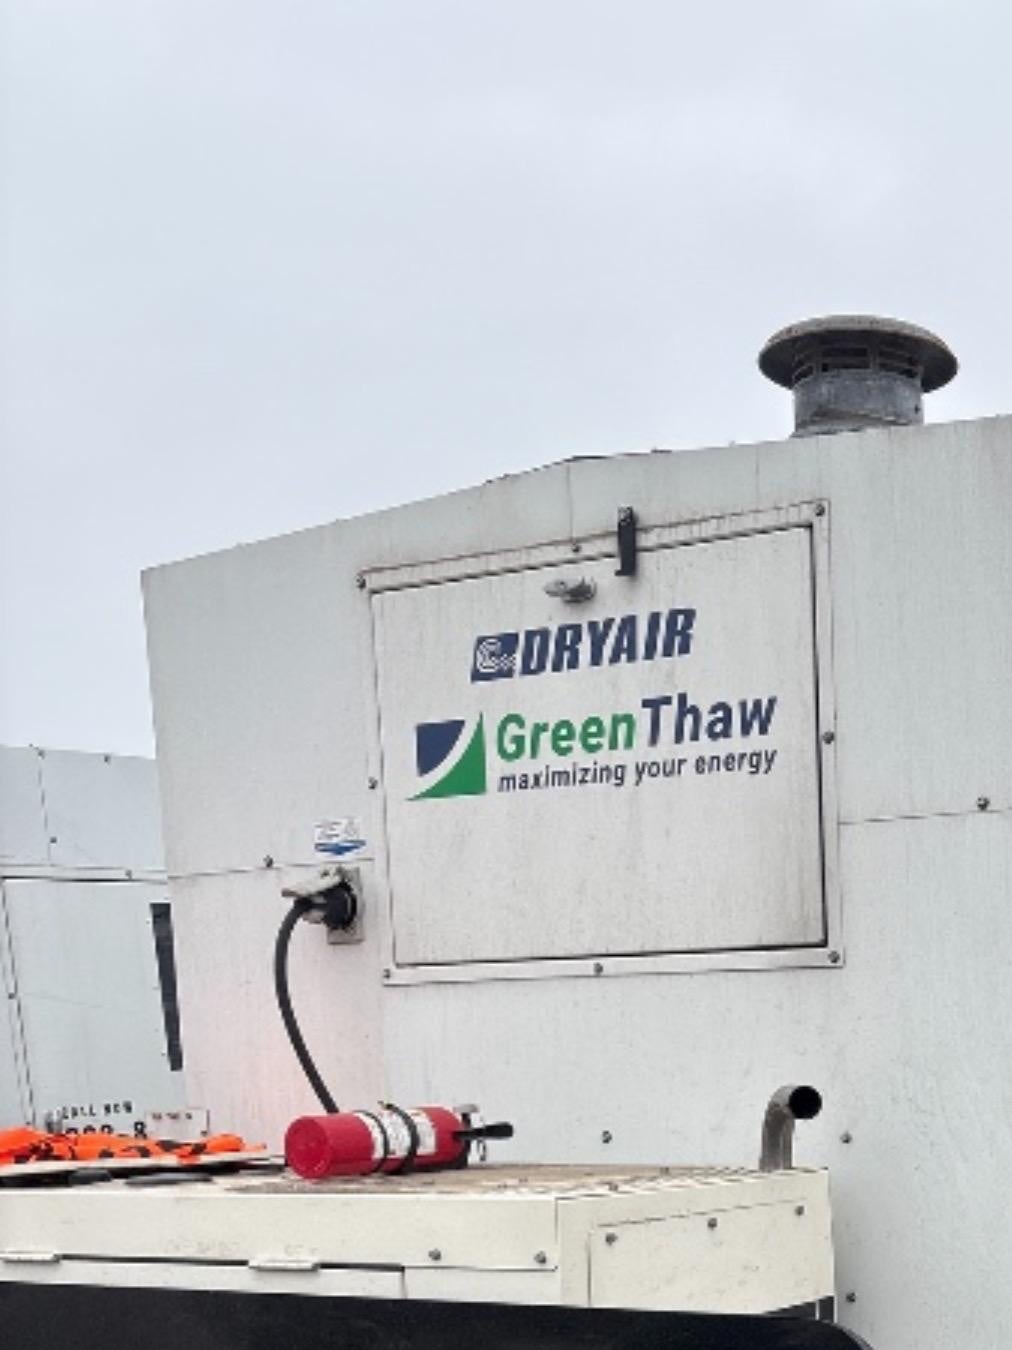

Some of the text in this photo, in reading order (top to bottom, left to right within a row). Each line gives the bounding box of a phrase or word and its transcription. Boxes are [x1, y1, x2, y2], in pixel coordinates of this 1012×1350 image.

[519, 608, 696, 676] DRYAIR
[496, 692, 778, 763] GreenThaw
[497, 749, 778, 792] maximizing your energy
